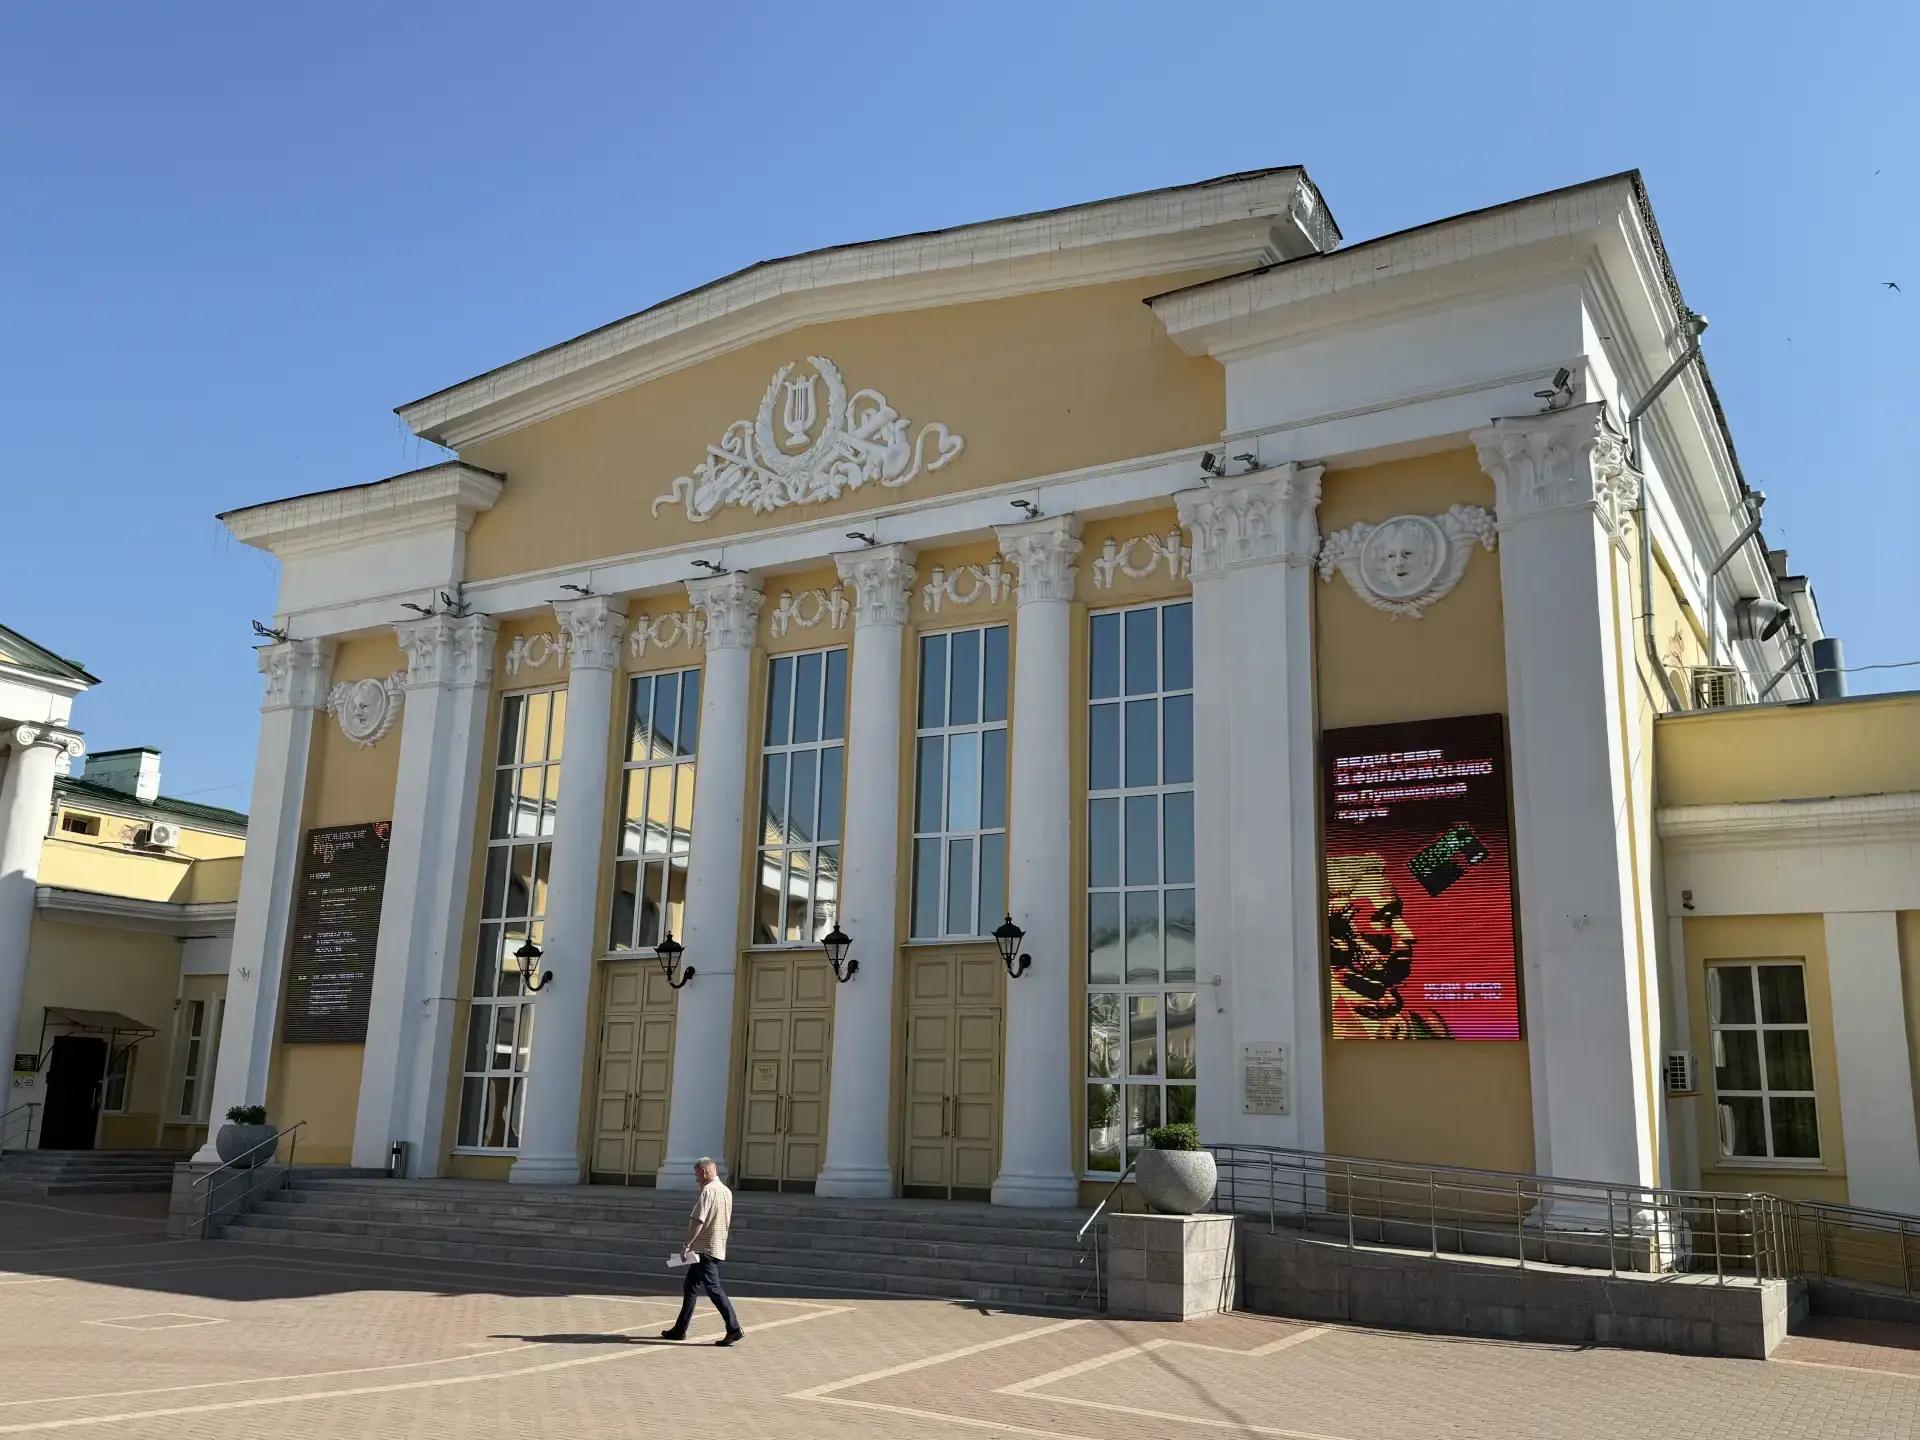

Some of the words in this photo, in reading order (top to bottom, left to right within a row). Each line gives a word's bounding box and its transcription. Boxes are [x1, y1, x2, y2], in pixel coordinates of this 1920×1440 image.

[1336, 753, 1387, 768] ВЕДИ
[1390, 749, 1443, 763] СЕБЯ
[1352, 761, 1493, 785] ФИЛАРМОНИЮ
[1360, 781, 1468, 803] Пушкинской
[1337, 807, 1389, 822] карте
